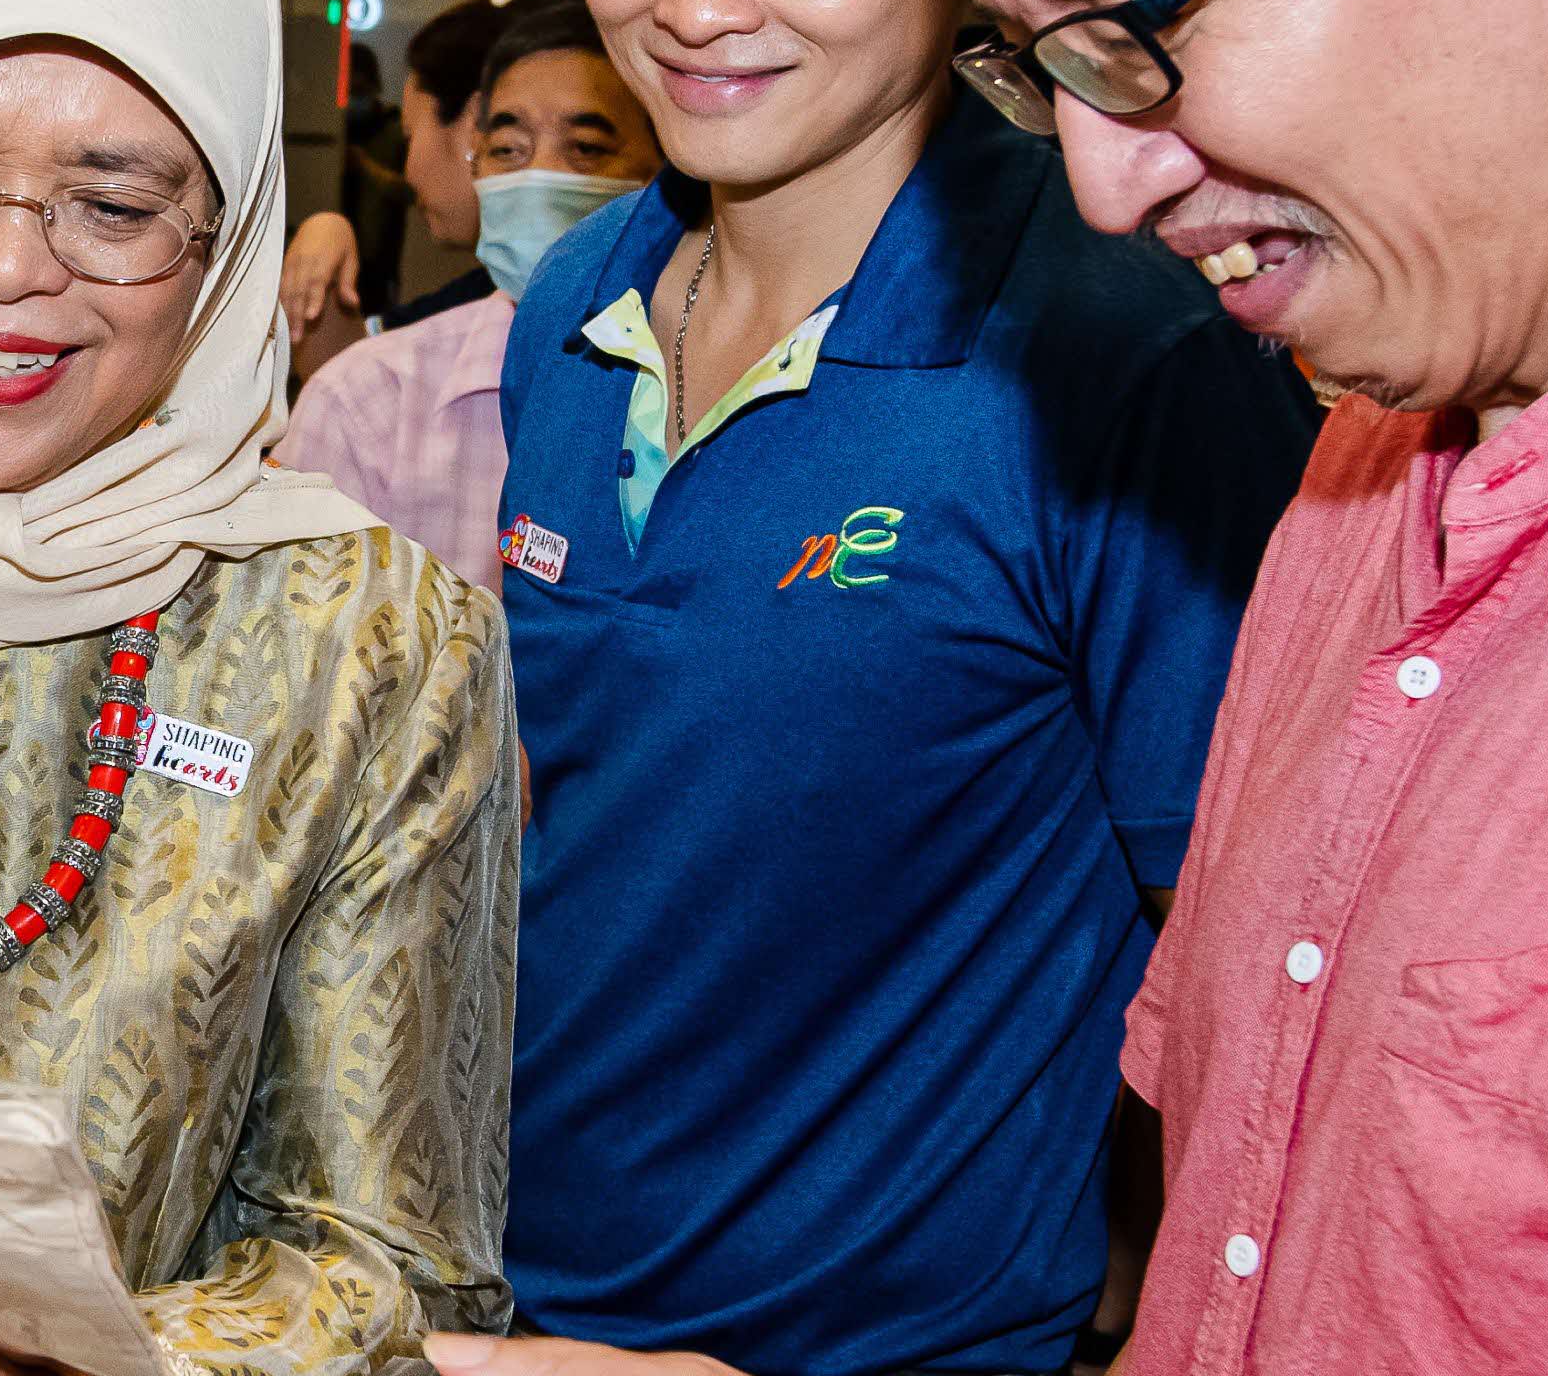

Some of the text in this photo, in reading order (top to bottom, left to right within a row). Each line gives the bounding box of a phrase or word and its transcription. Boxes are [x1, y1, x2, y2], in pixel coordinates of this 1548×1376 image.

[529, 526, 564, 558] SHAPING
[522, 546, 559, 580] hearts
[162, 723, 247, 763] SHAPING
[153, 744, 240, 792] hearts
